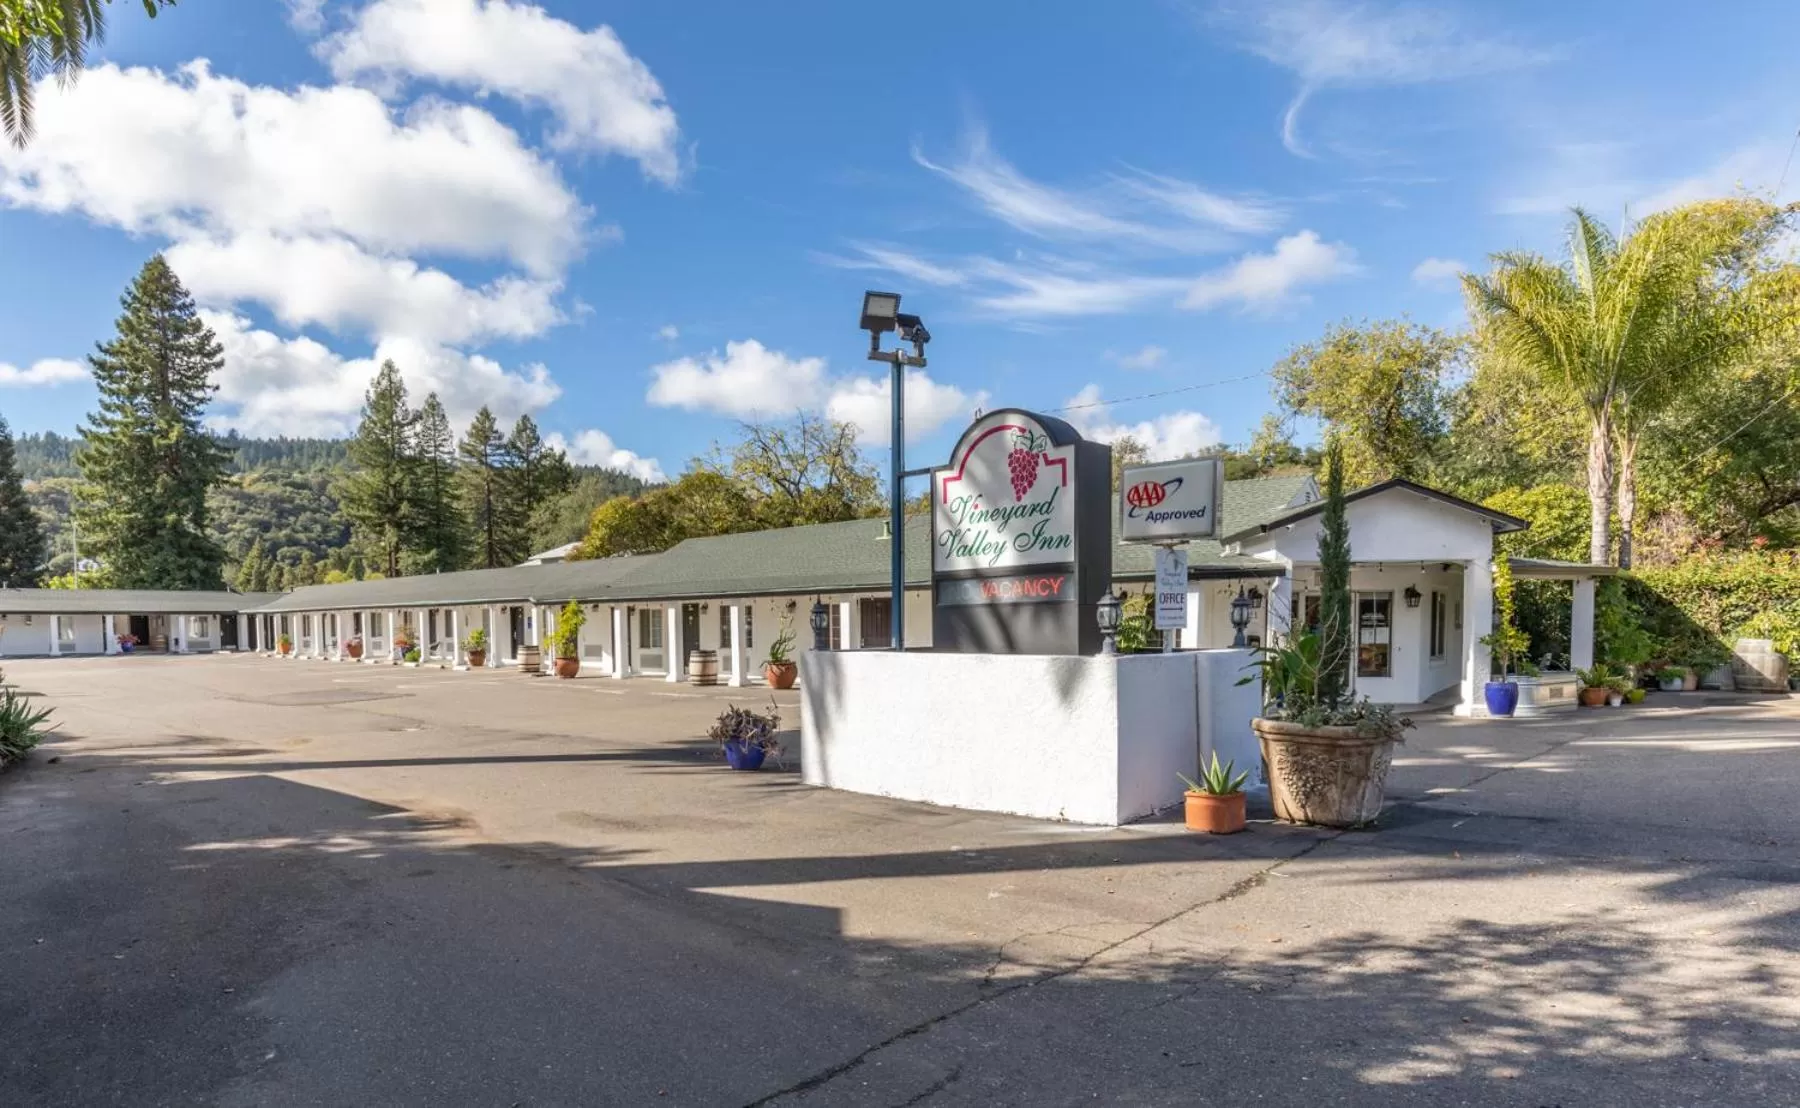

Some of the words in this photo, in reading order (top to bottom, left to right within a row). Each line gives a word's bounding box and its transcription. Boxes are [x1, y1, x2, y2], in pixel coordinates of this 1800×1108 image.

[1130, 482, 1163, 507] AAA
[949, 486, 1059, 533] Vineyard
[1145, 505, 1206, 523] Approved
[938, 528, 1007, 567] Valley
[1013, 518, 1072, 552] Inn
[982, 576, 1064, 597] VACANCY
[1159, 592, 1184, 604] OFFICE
